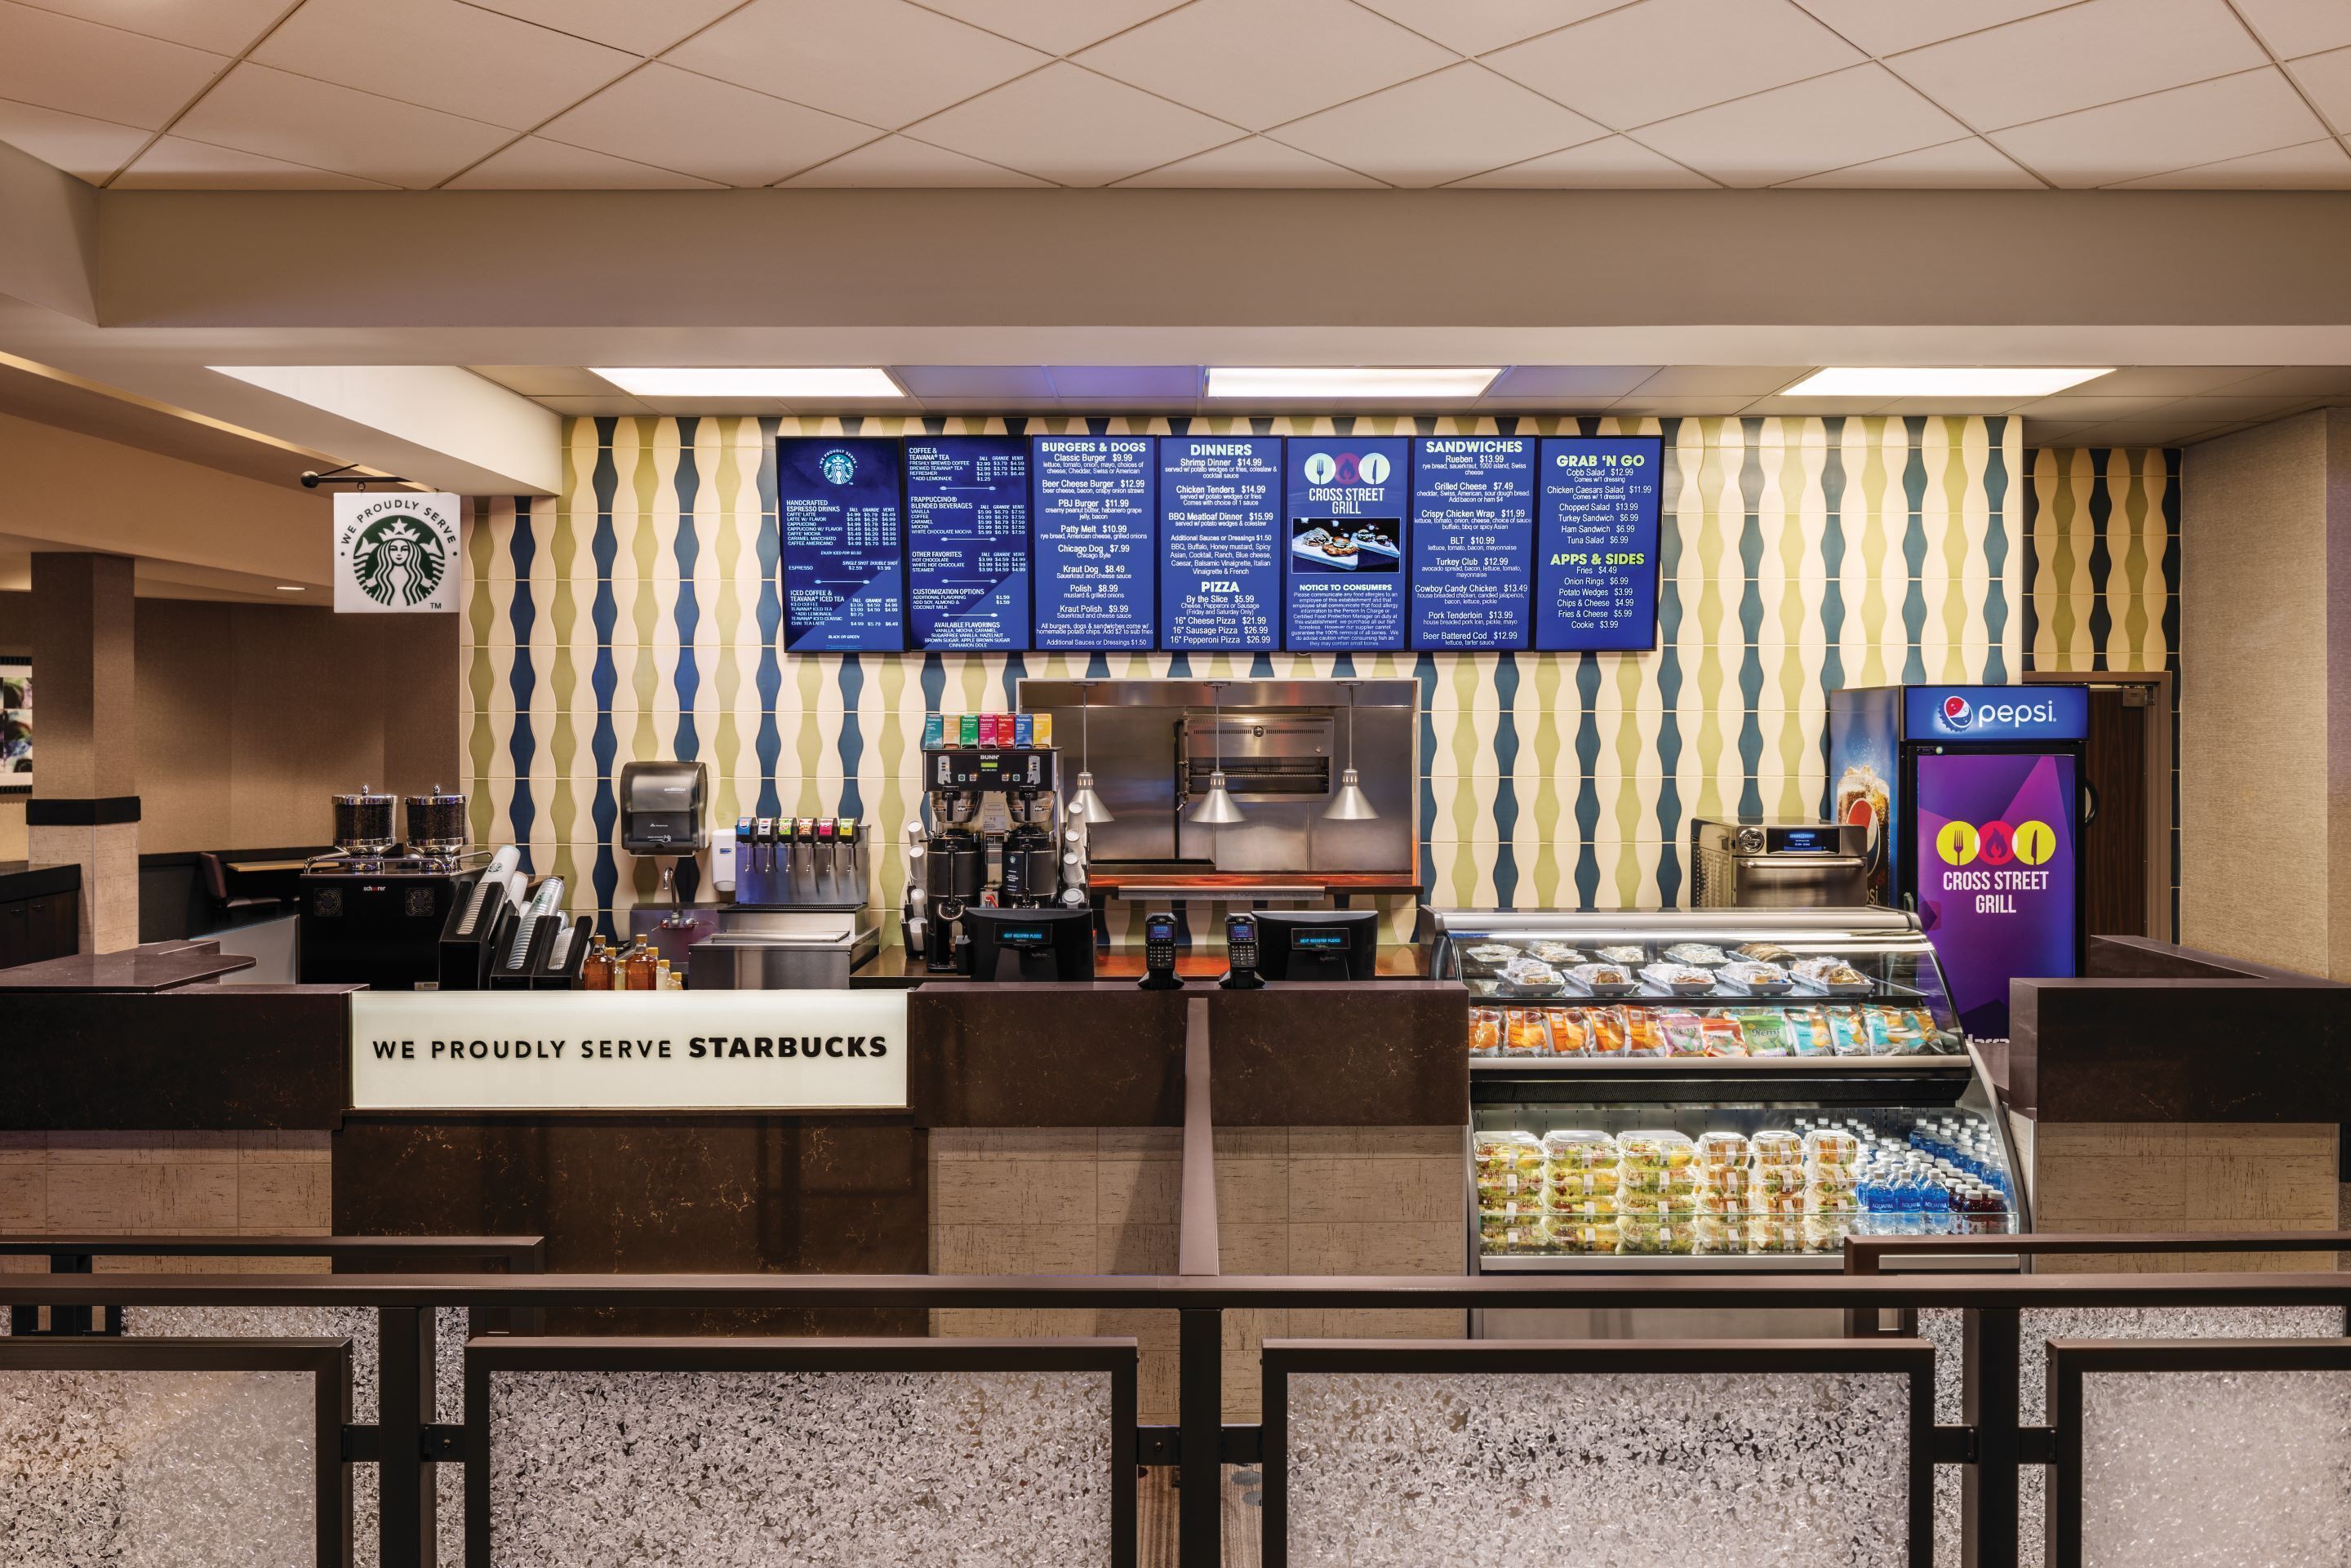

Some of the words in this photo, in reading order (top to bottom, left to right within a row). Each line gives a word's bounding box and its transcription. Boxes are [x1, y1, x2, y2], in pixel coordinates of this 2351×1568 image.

[1042, 442, 1096, 452] BURGERS
[1099, 442, 1107, 452] &
[1111, 442, 1146, 452] DOGS
[1191, 444, 1252, 455] DINNERS
[1426, 441, 1522, 453] SANDWICHES
[1054, 453, 1080, 461] Classic
[1082, 454, 1106, 462] Burger
[1113, 453, 1132, 462] $9.99
[1446, 455, 1473, 463] Rueben
[1480, 455, 1504, 463] $13.99
[1557, 455, 1598, 467] GRAB
[1620, 455, 1645, 466] GO
[1180, 458, 1206, 467] Shrimp
[1207, 458, 1231, 467] Dinner
[1236, 458, 1262, 467] $14.99
[1586, 468, 1605, 476] Salad
[1611, 468, 1633, 476] $12.99
[1042, 479, 1060, 489] Beer
[1061, 479, 1088, 489] Cheese
[1090, 480, 1114, 489] Burger
[1121, 479, 1144, 489] $12.99
[1434, 482, 1458, 491] Grilled
[1460, 482, 1487, 491] Cheese
[1493, 482, 1513, 491] $7.49
[1176, 485, 1205, 493] Chicken
[1207, 486, 1235, 494] Tenders
[1242, 485, 1265, 494] $14.99
[1309, 488, 1343, 501] CROSS
[1345, 488, 1384, 501] STREET
[1058, 499, 1073, 507] PBJ
[1074, 500, 1099, 508] Burger
[1105, 499, 1130, 508] $11.99
[1332, 500, 1361, 514] GRILL
[1559, 503, 1589, 513] Chopped
[1591, 503, 1610, 511] Salad
[1615, 503, 1638, 511] $13.99
[1169, 513, 1185, 521] BBQ
[1187, 513, 1218, 521] Meatloaf
[1220, 513, 1242, 521] Dinner
[1249, 512, 1273, 521] $15.99
[1558, 514, 1580, 523] Turkey
[1620, 513, 1638, 522] $6.99
[341, 525, 357, 544] WE
[357, 500, 420, 523] PROUDLY
[424, 508, 456, 544] SERVE
[1061, 525, 1079, 534] Patty
[1081, 525, 1096, 534] Melt
[1103, 525, 1127, 534] $10.99
[1451, 536, 1464, 544] BLT
[1470, 536, 1495, 545] $10.99
[1585, 535, 1604, 544] Salad
[1610, 535, 1629, 544] $6.99
[1057, 544, 1087, 553] Chicago
[1088, 544, 1104, 553] Dog
[1109, 544, 1131, 553] $7.99
[1436, 557, 1460, 566] Turkey
[1460, 557, 1478, 566] Club
[1483, 557, 1509, 566] $12.99
[1550, 553, 1587, 565] APPS
[1591, 553, 1602, 565] &
[1606, 553, 1644, 565] SIDES
[1063, 565, 1082, 574] Kraut
[1084, 565, 1099, 574] Dog
[1104, 565, 1125, 574] $8.49
[1598, 566, 1617, 575] $4.49
[1564, 577, 1584, 585] Onion
[1585, 577, 1604, 586] Rings
[1610, 577, 1629, 585] $6.99
[1070, 584, 1091, 593] Polish
[1098, 584, 1118, 593] $8.99
[1202, 581, 1240, 593] PIZZA
[1582, 589, 1608, 597] Wedges
[1614, 588, 1633, 596] $3.99
[1185, 595, 1196, 604] By
[1198, 595, 1209, 604] the
[1211, 595, 1229, 604] Slice
[1234, 595, 1255, 604] $5.99
[1489, 611, 1513, 620] $13.99
[1571, 620, 1594, 629] Cookie
[1600, 620, 1619, 629] $3.99
[1979, 700, 2053, 728] pepsi
[1943, 871, 1991, 891] CROSS
[1994, 871, 2049, 891] STREET
[1975, 895, 2016, 913] GRILL
[372, 1041, 415, 1059] WE
[431, 1040, 566, 1059] PROUDLY
[581, 1040, 671, 1059] SERVE
[689, 1036, 887, 1059] STARBUCKS
